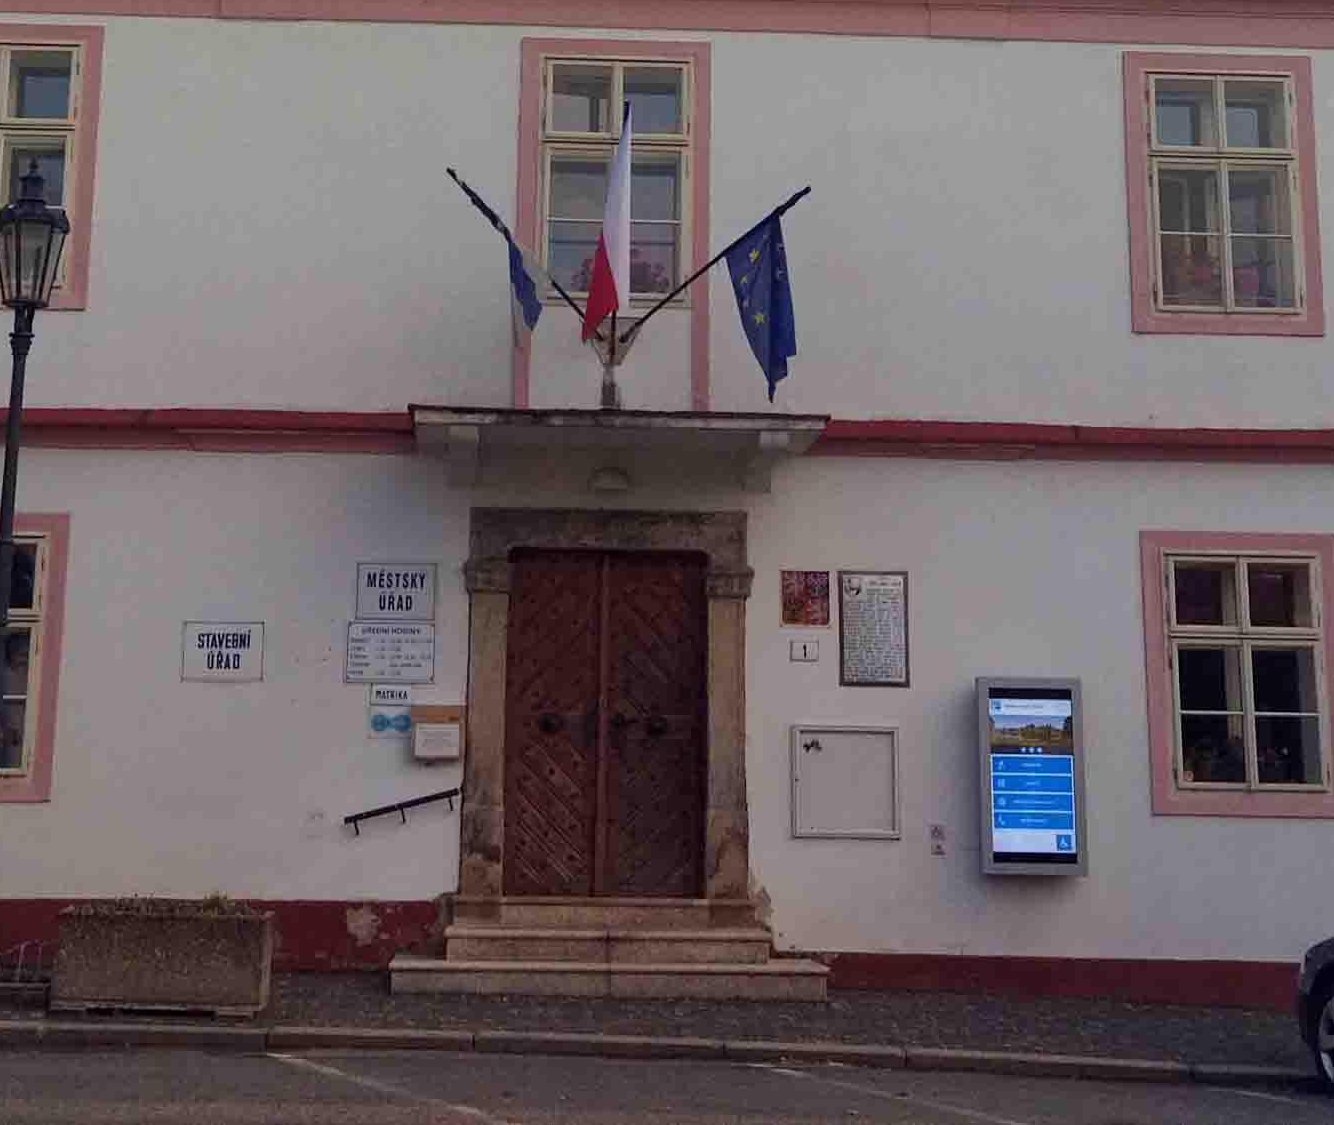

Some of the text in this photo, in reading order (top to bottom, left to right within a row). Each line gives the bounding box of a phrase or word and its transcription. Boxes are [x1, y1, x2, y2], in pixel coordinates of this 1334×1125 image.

[379, 590, 413, 611] ÚŘAD
[197, 629, 251, 649] STAVEBNÍ
[207, 650, 240, 670] ÚŘAD
[375, 690, 408, 700] MATRIKA
